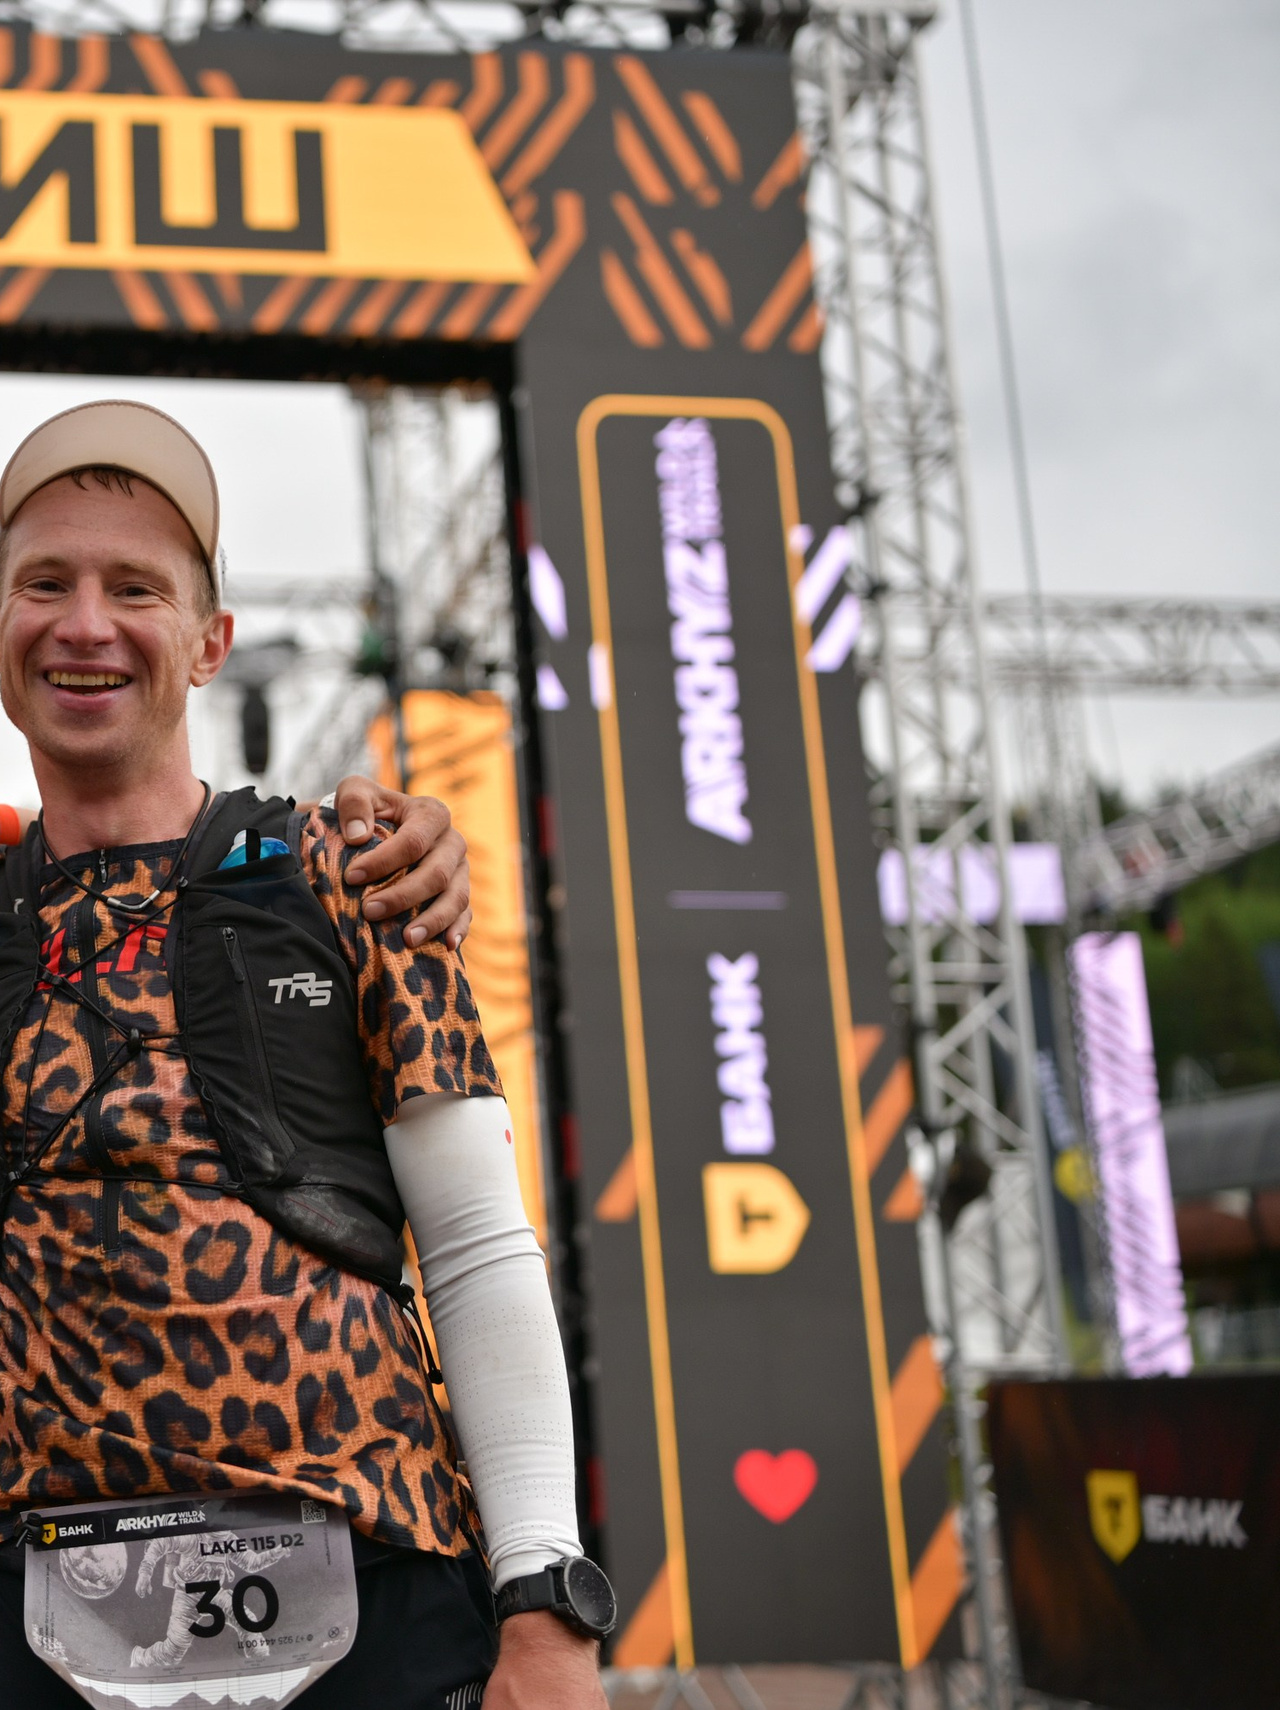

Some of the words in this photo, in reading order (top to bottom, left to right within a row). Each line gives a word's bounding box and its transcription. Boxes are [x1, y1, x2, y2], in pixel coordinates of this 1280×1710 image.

[662, 538, 754, 846] ARKHYZ
[268, 972, 333, 1007] TRS
[706, 950, 776, 1156] БАНК
[58, 1524, 94, 1537] БАНК
[115, 1512, 179, 1532] ARKHYZ
[1142, 1494, 1250, 1549] БАНК
[200, 1539, 248, 1557] LAKE
[251, 1535, 276, 1551] 115
[280, 1533, 305, 1548] D2
[184, 1574, 280, 1639] 30
[237, 1641, 245, 1649] 11
[245, 1639, 258, 1648] 00
[260, 1637, 277, 1647] 444
[278, 1635, 294, 1645] 925
